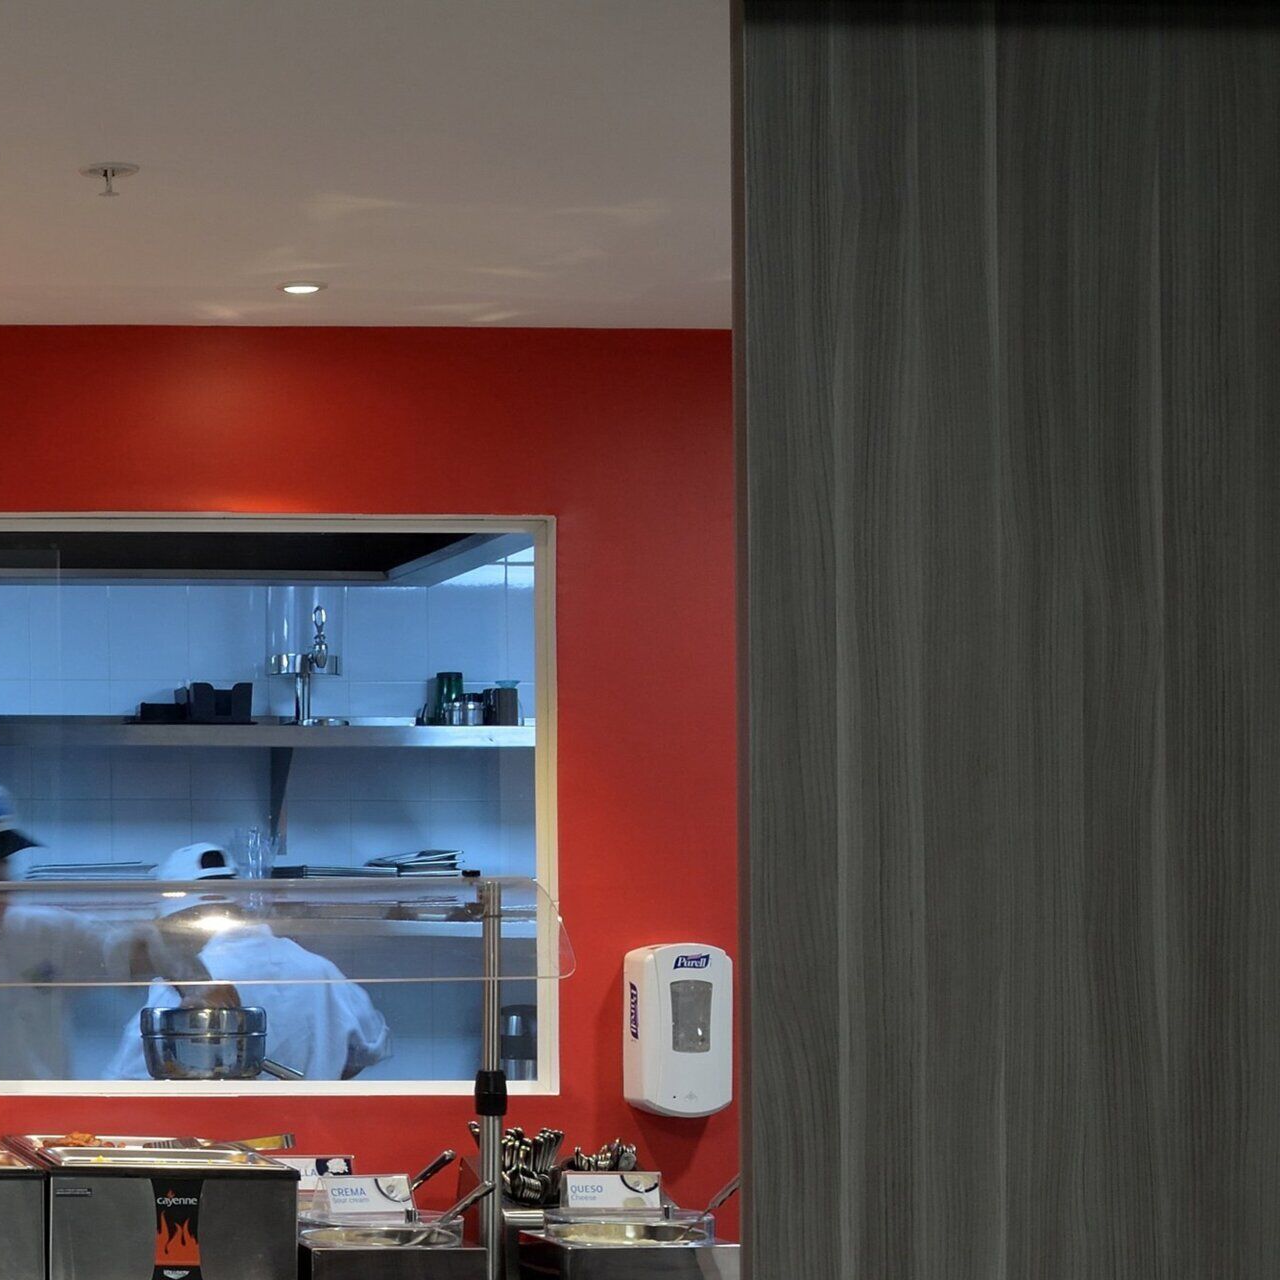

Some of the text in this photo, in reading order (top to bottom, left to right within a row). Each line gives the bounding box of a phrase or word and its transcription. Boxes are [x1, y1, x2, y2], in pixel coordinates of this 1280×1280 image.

[677, 956, 706, 968] Purell
[330, 1187, 367, 1197] CREMA
[570, 1184, 604, 1194] QUESO
[156, 1196, 198, 1208] cayenne
